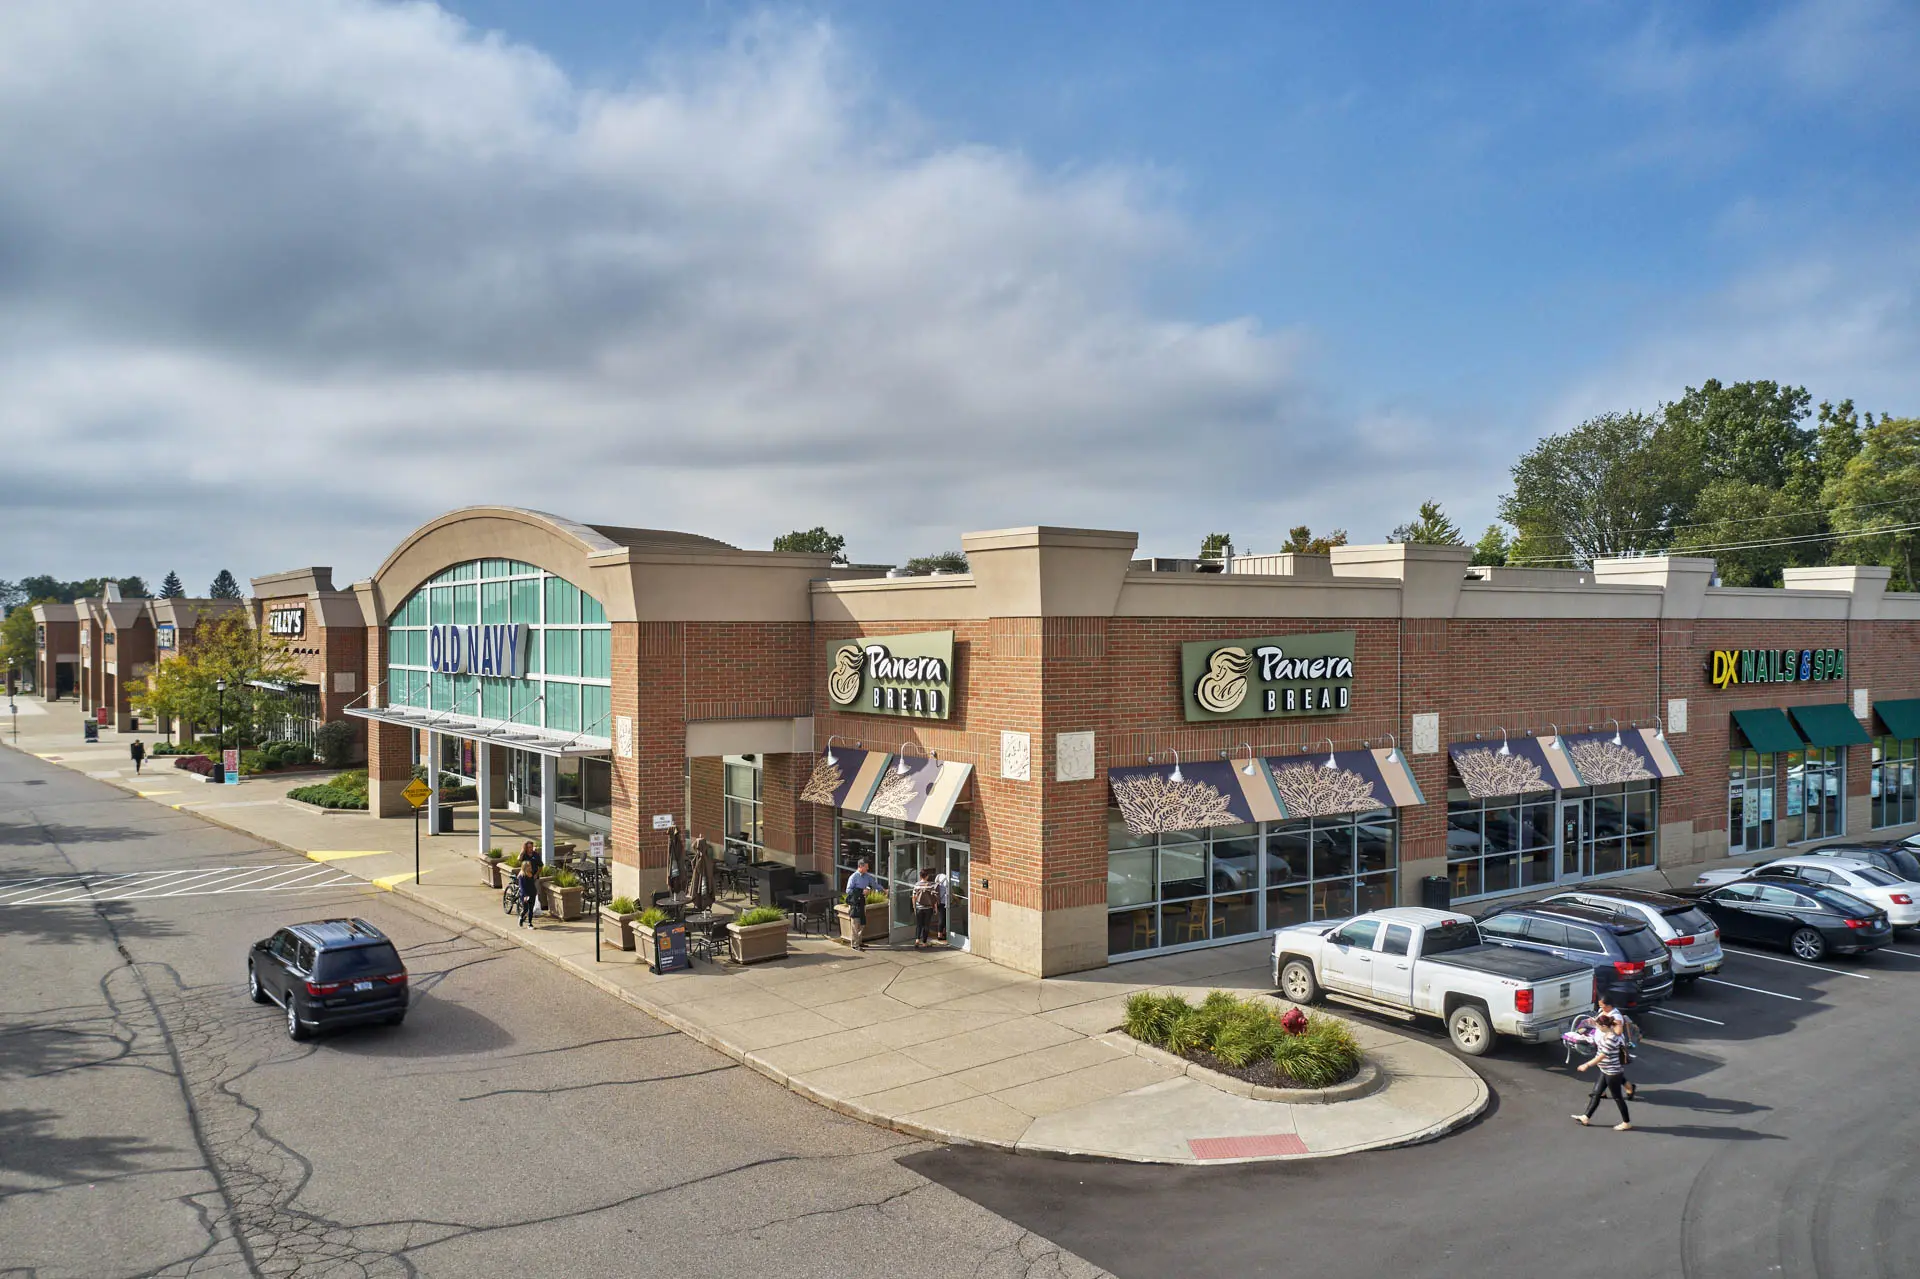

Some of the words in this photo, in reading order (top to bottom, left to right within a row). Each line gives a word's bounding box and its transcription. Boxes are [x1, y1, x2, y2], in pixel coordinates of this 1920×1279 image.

[431, 625, 461, 673] OLD
[467, 624, 520, 678] NAVY
[865, 644, 942, 681] Panera
[1256, 646, 1354, 681] Panera
[1712, 650, 1739, 689] DX
[1741, 649, 1796, 684] NAILS
[1799, 649, 1811, 682] &
[1813, 648, 1845, 681] SPA
[873, 687, 937, 712] BREAD
[1267, 687, 1349, 711] BREAD
